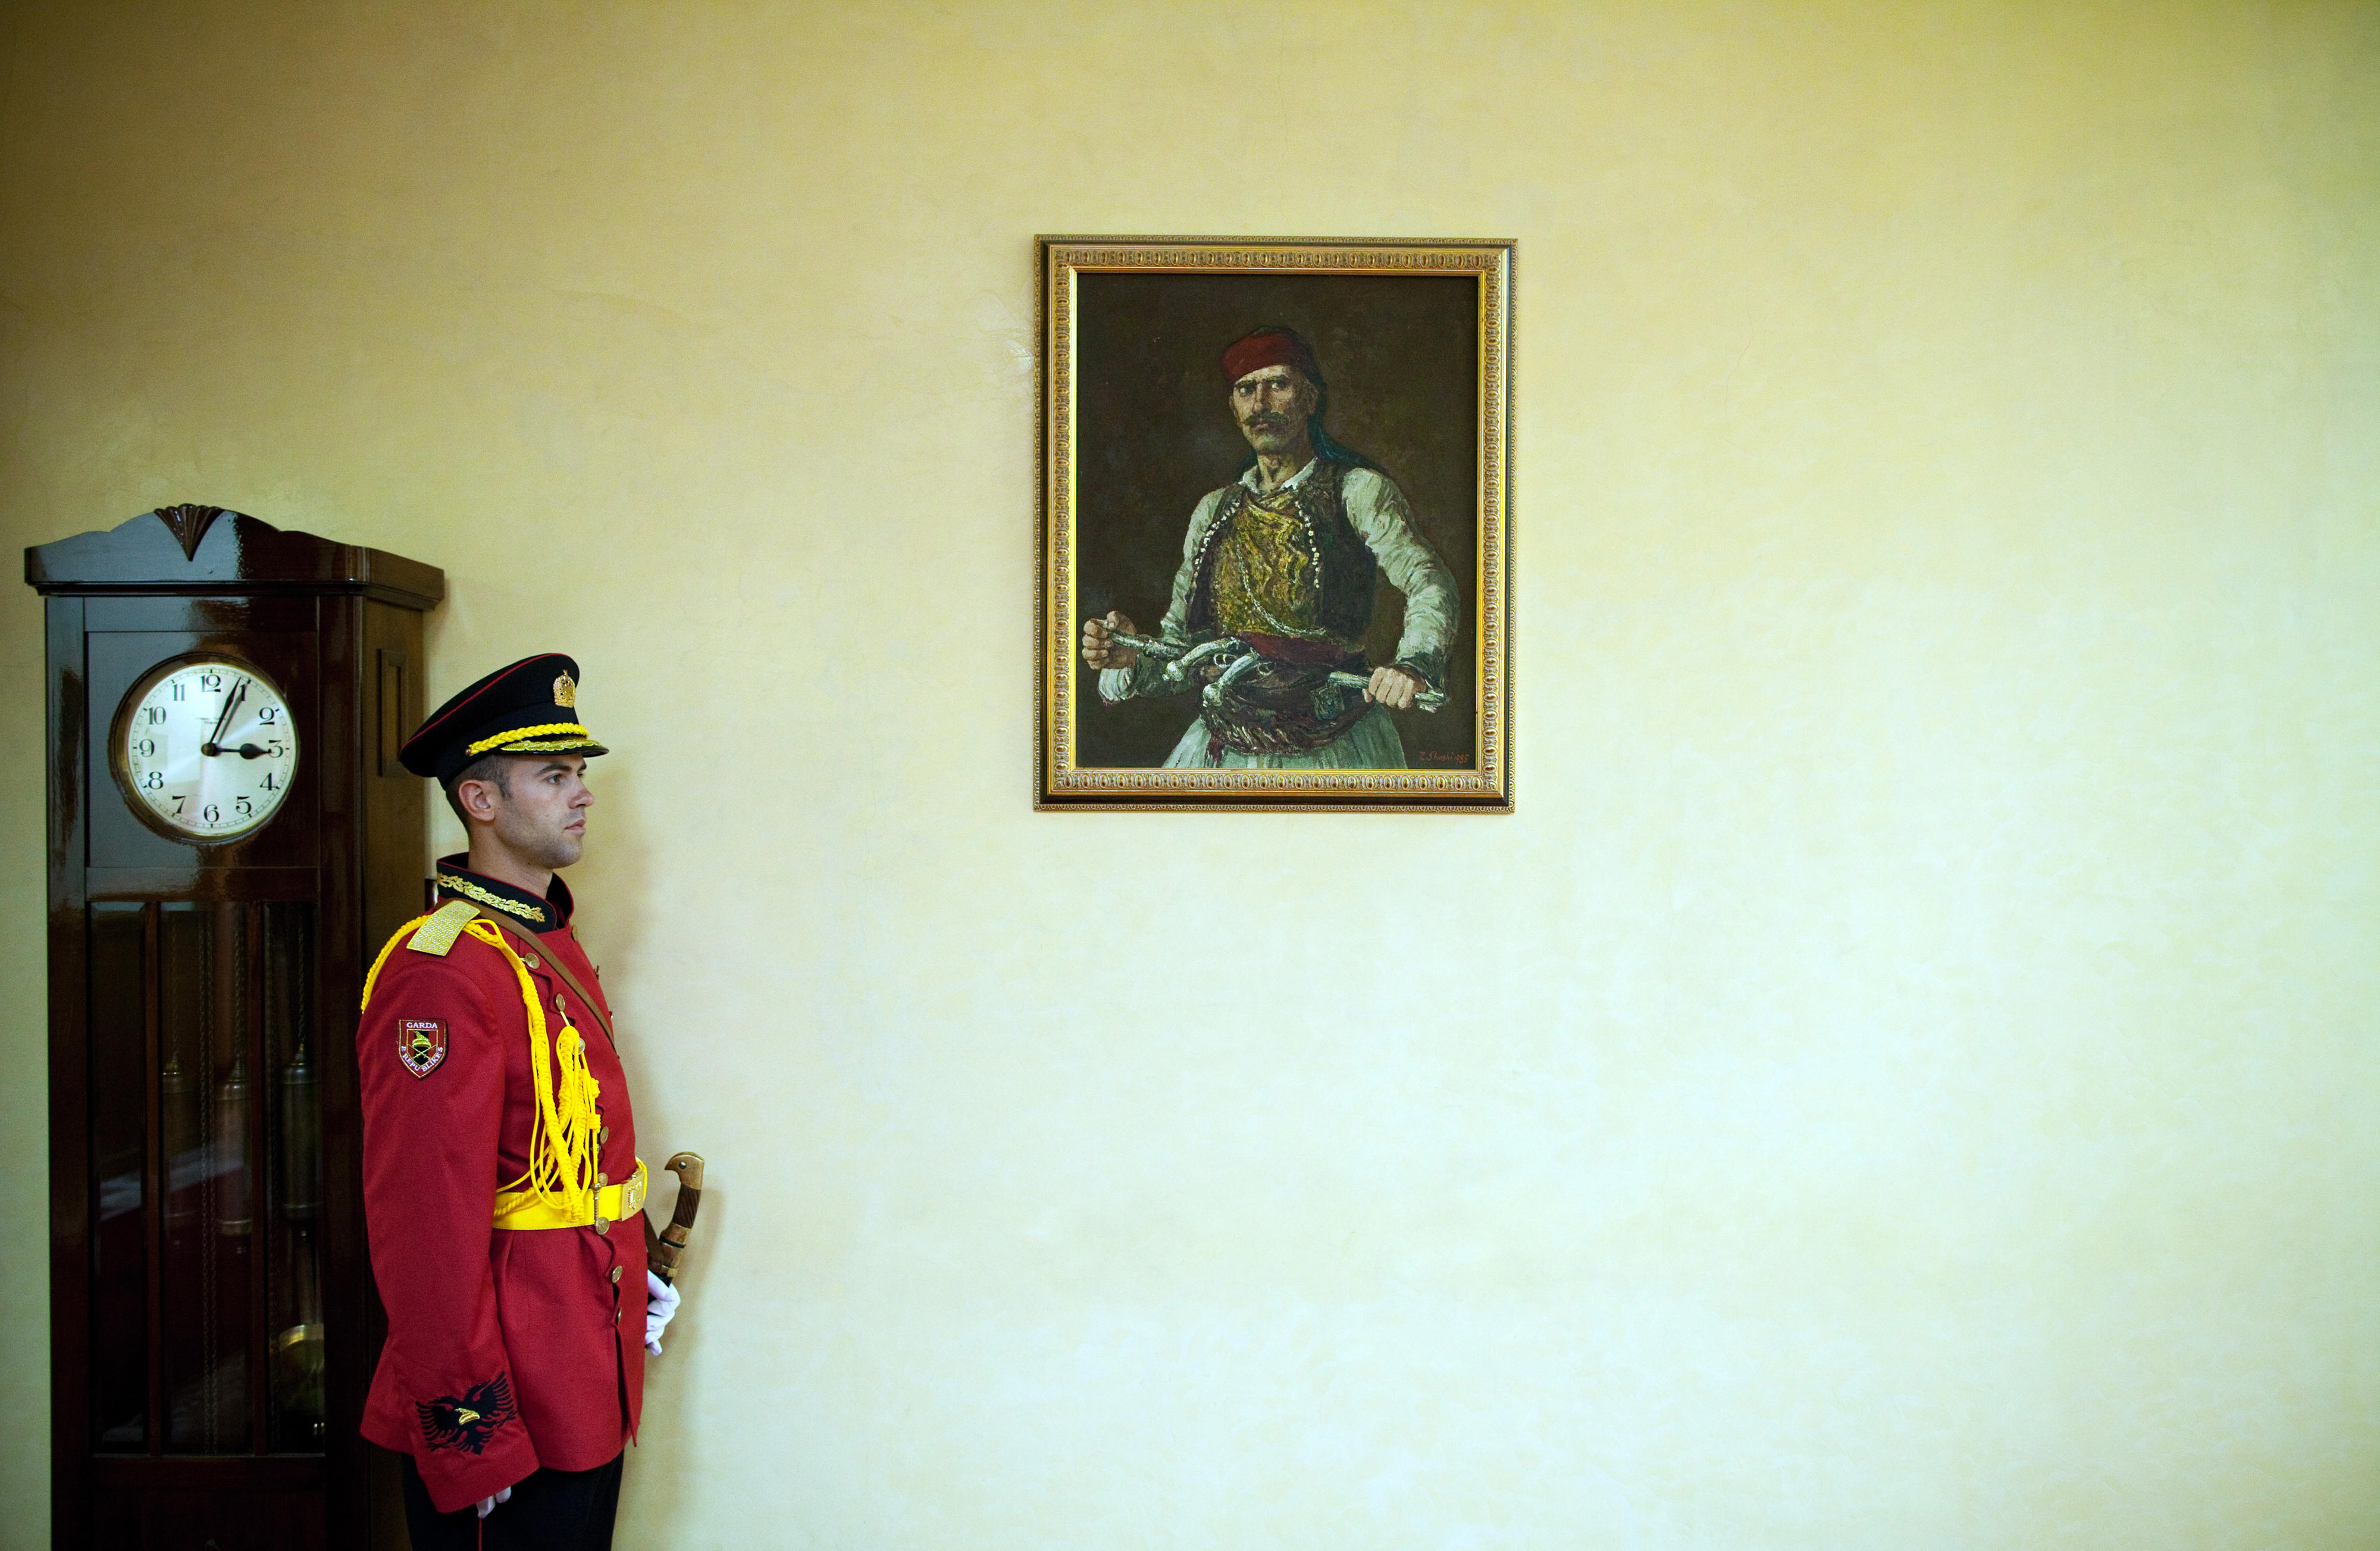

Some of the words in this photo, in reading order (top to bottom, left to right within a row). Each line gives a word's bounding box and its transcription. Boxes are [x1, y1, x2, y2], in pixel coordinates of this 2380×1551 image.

[172, 683, 186, 701] 11
[200, 674, 221, 692] 12
[239, 683, 246, 701] 1
[148, 706, 167, 725] 10
[259, 706, 275, 725] 2
[139, 739, 155, 757] 9
[268, 739, 284, 758] 3
[148, 771, 164, 790] 8
[259, 772, 275, 790] 4
[171, 795, 186, 814] 7
[203, 804, 220, 823] 6
[236, 796, 252, 814] 5
